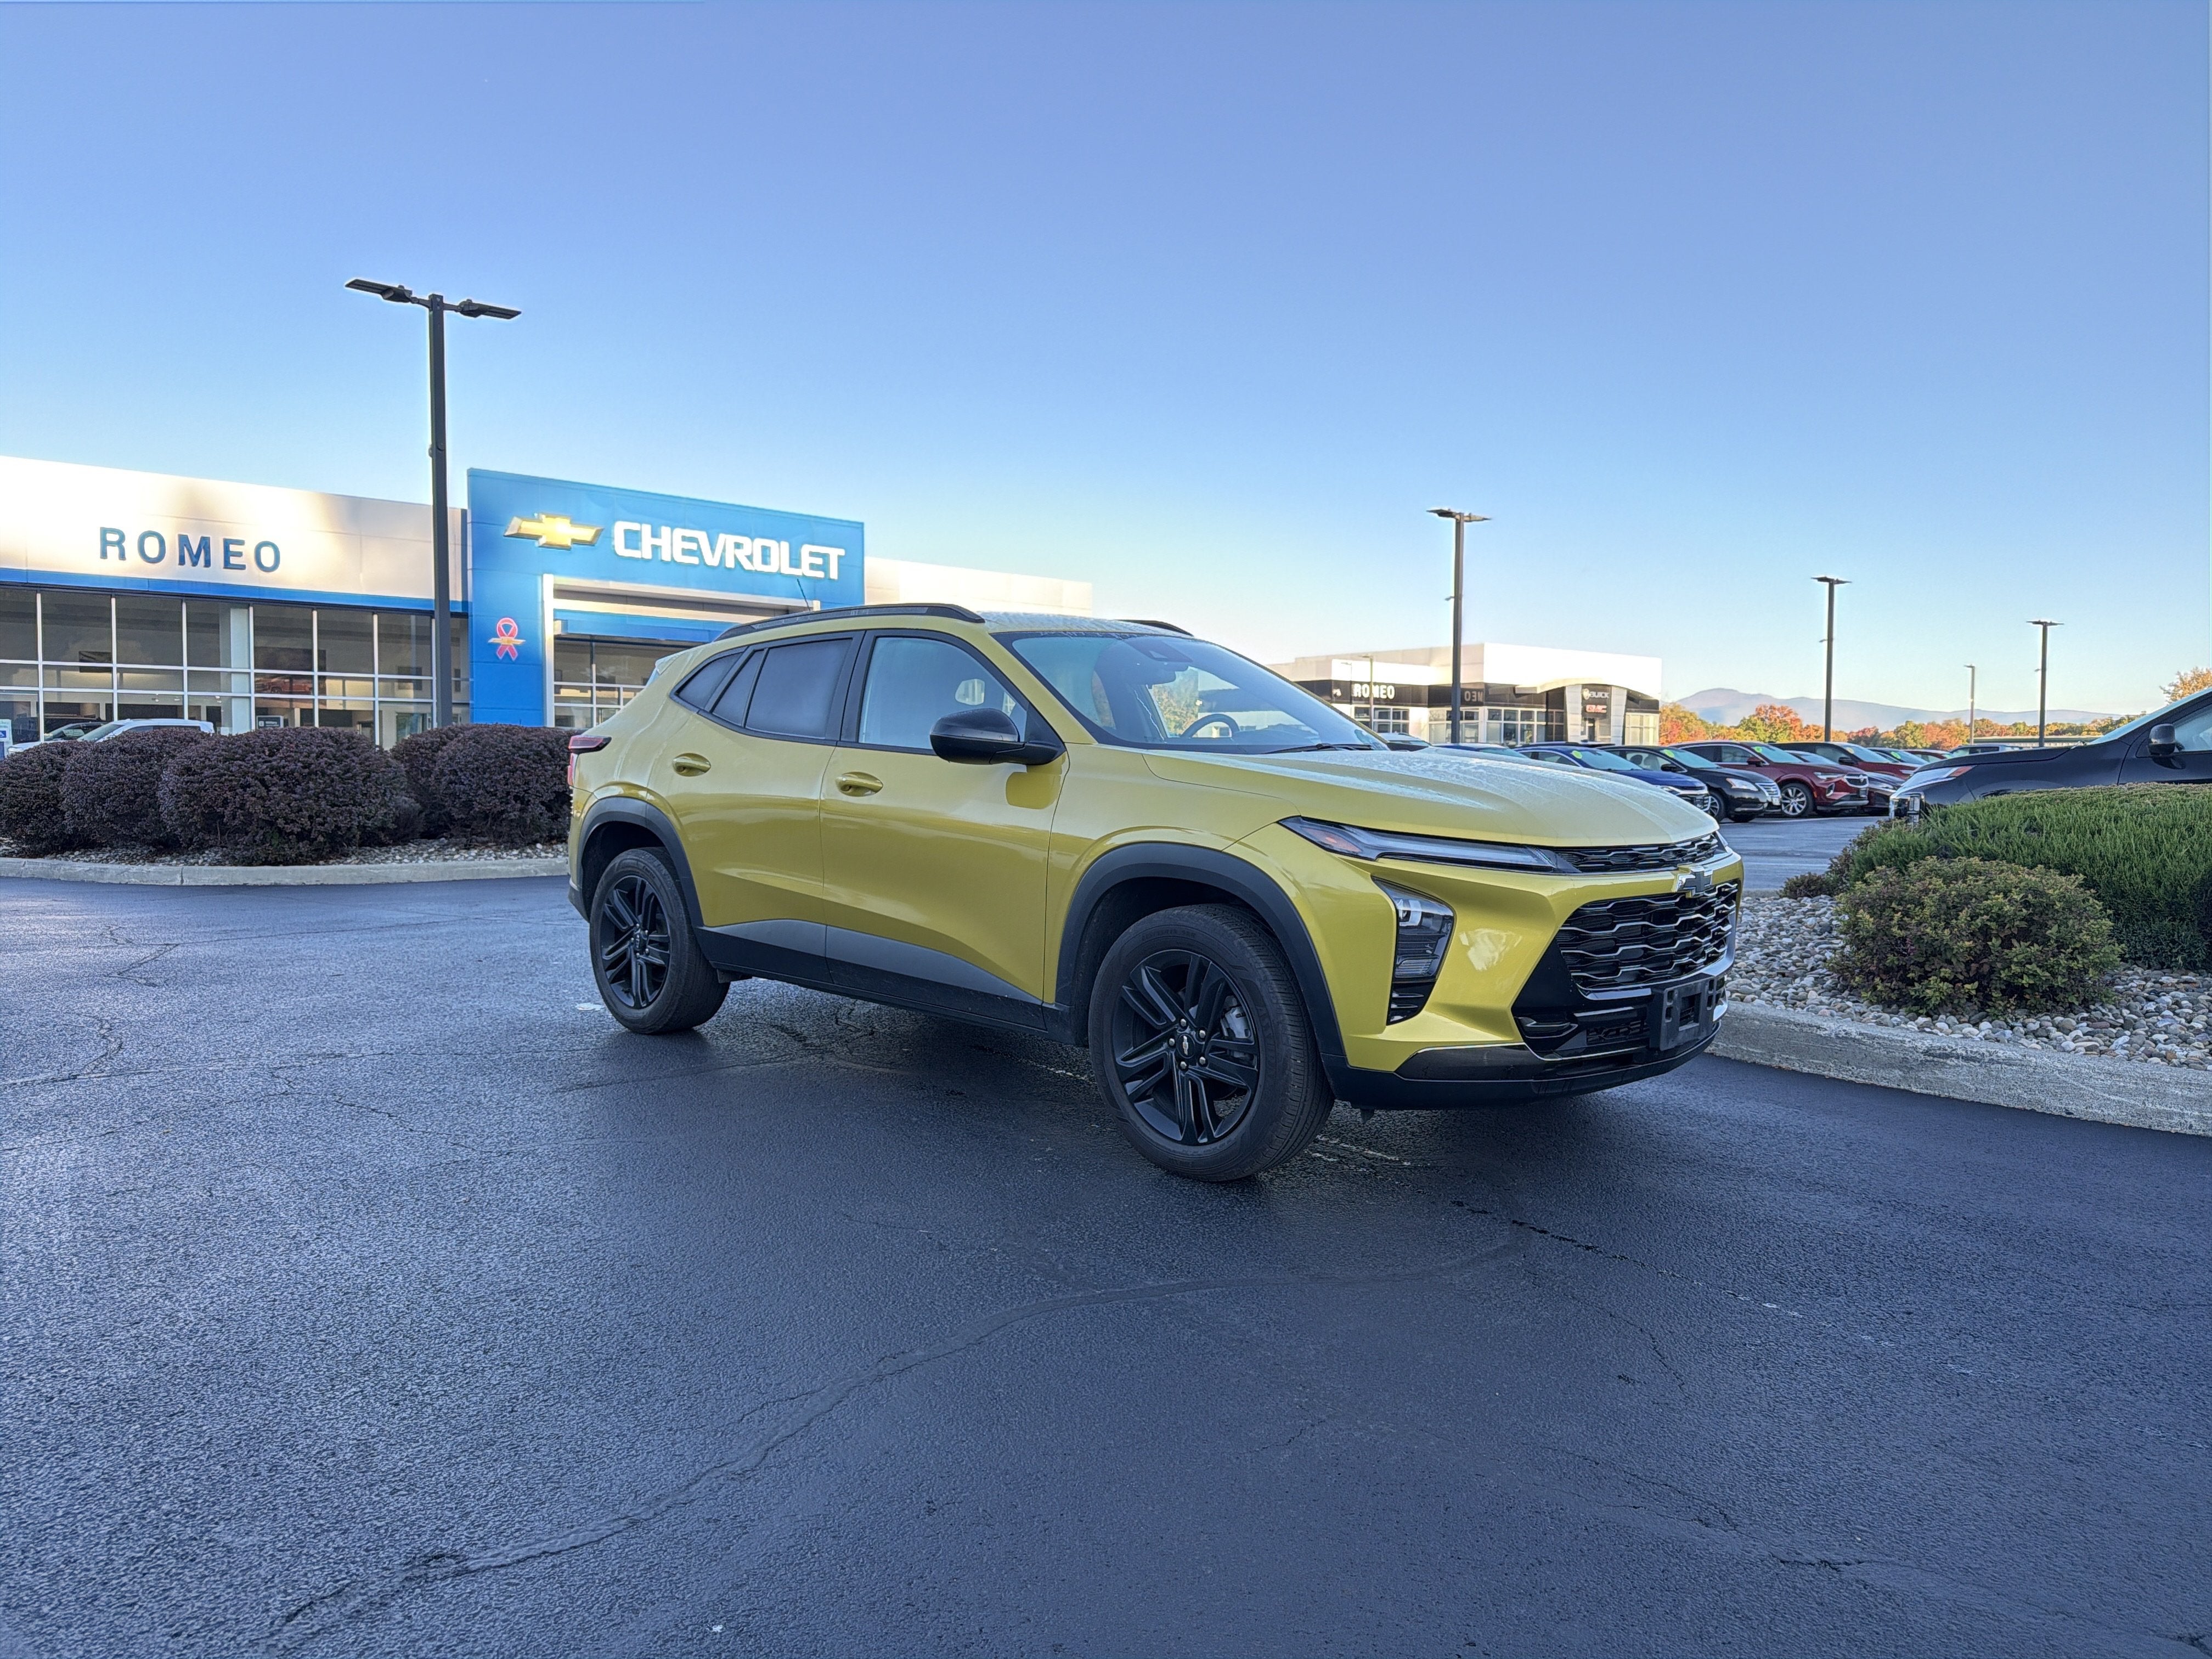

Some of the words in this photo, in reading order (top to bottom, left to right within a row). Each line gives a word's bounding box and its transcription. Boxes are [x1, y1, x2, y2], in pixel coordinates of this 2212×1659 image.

[99, 526, 281, 573] ROMEO
[613, 521, 846, 580] CHEVROLET
[1352, 683, 1395, 699] ROMEO
